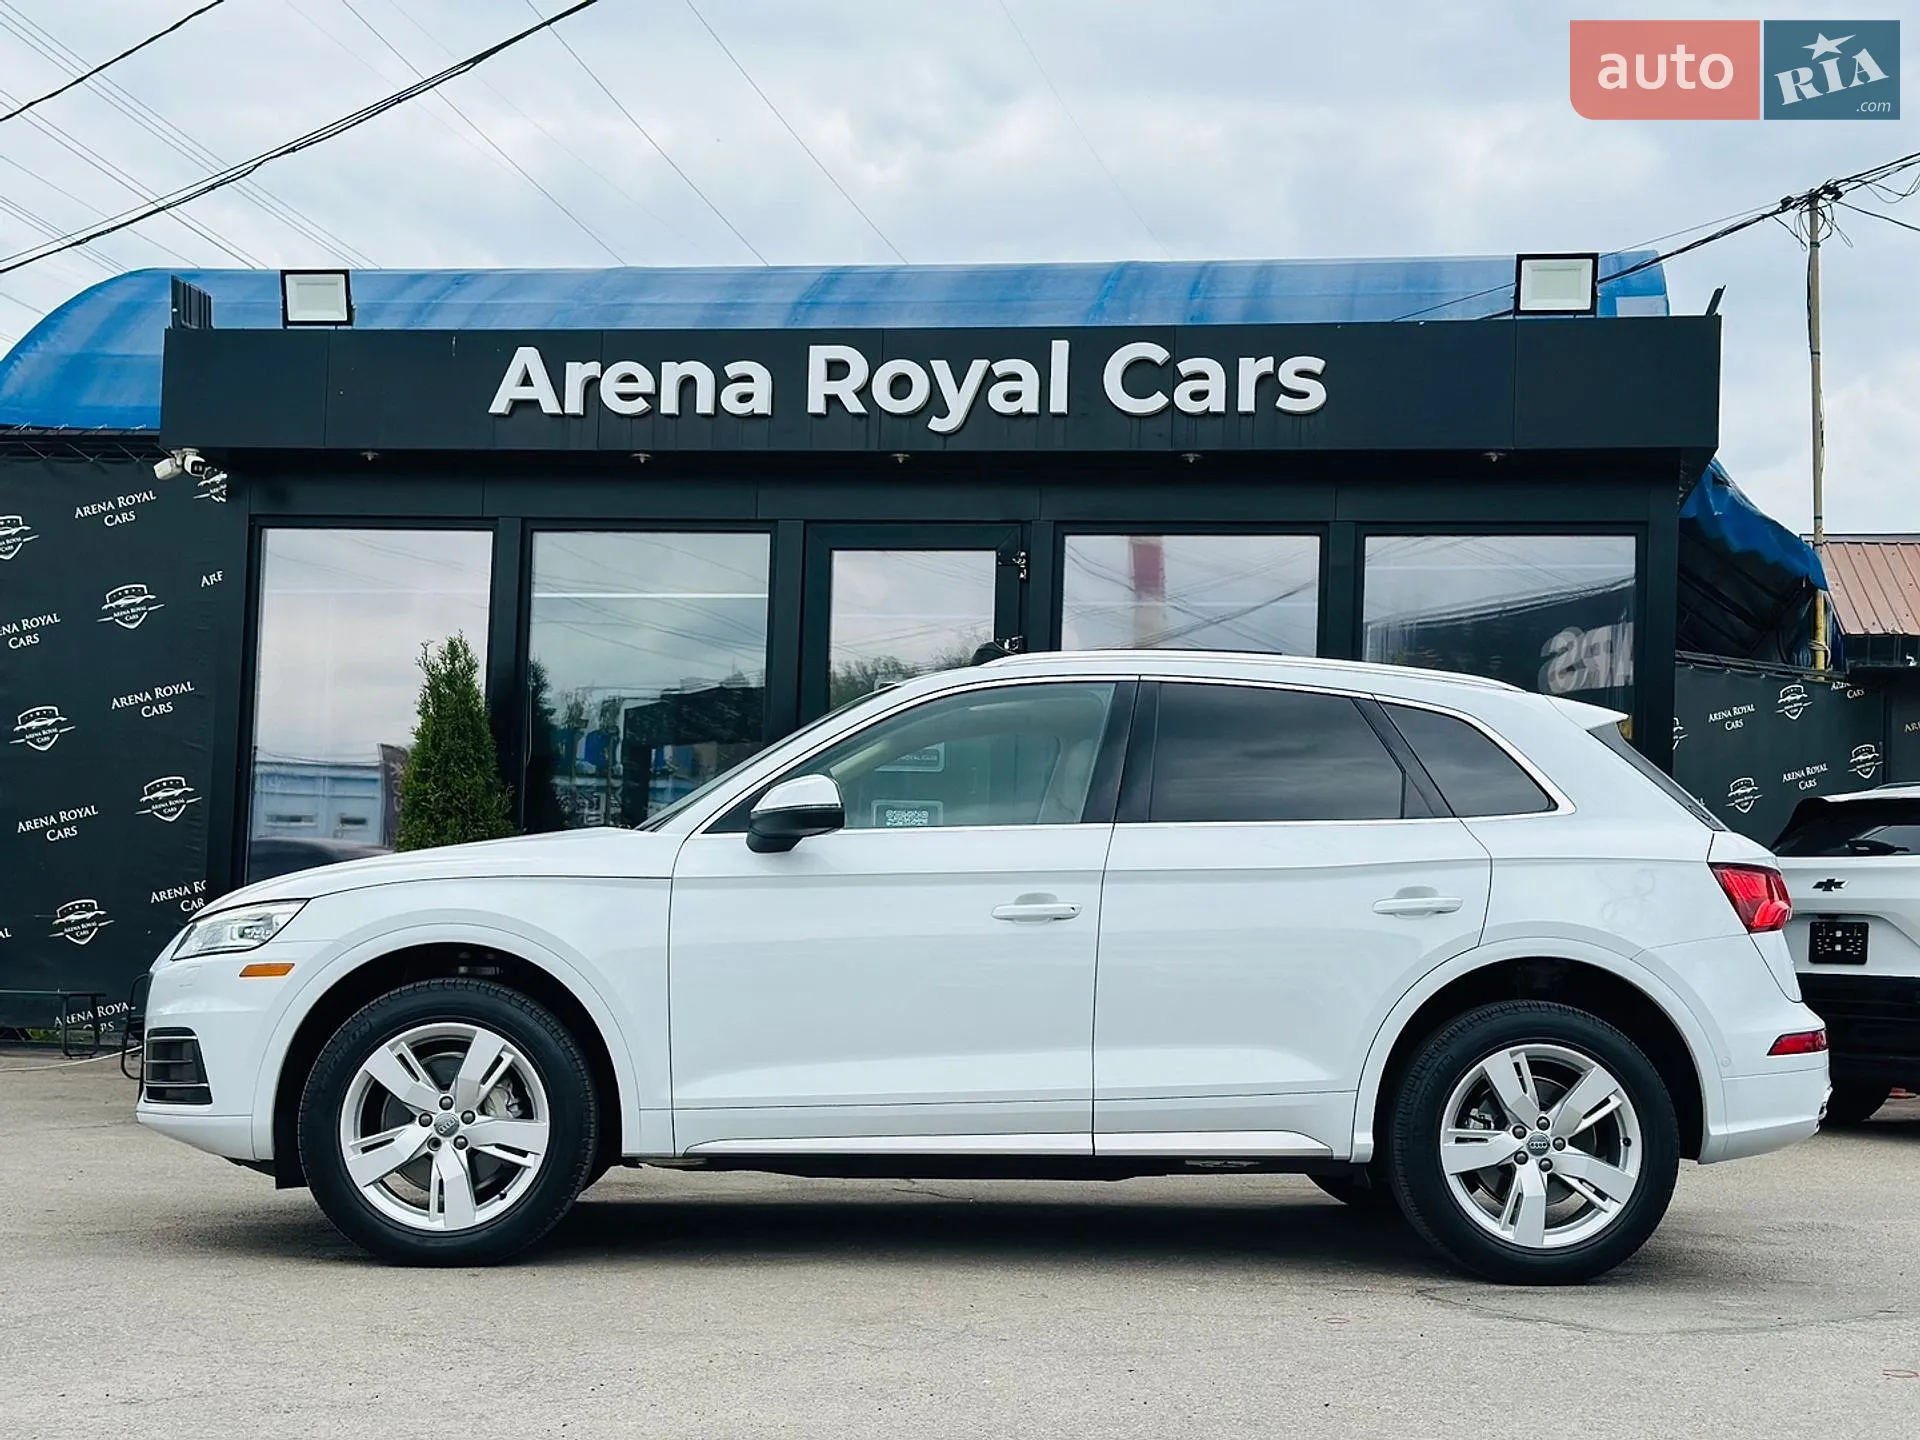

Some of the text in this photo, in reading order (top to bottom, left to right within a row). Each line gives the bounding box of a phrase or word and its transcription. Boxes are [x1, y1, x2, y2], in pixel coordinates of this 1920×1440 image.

[488, 339, 1327, 433] Arena Royal Cars
[74, 490, 157, 519] ARENA ROYAL
[104, 511, 136, 527] CARS
[21, 613, 61, 630] ROYAL
[8, 633, 40, 649] CARS
[111, 681, 195, 710] ARENA ROYAL
[141, 702, 173, 718] CARS
[1709, 703, 1755, 723] ARENA ROYAL
[1725, 719, 1744, 731] CARS
[1905, 721, 1920, 733] AR
[1782, 763, 1828, 783] ARENA ROYAL
[1798, 778, 1817, 791] CARS
[17, 805, 98, 834] ARENA ROYAL
[46, 825, 78, 842] CARS
[150, 885, 192, 904] ARENA
